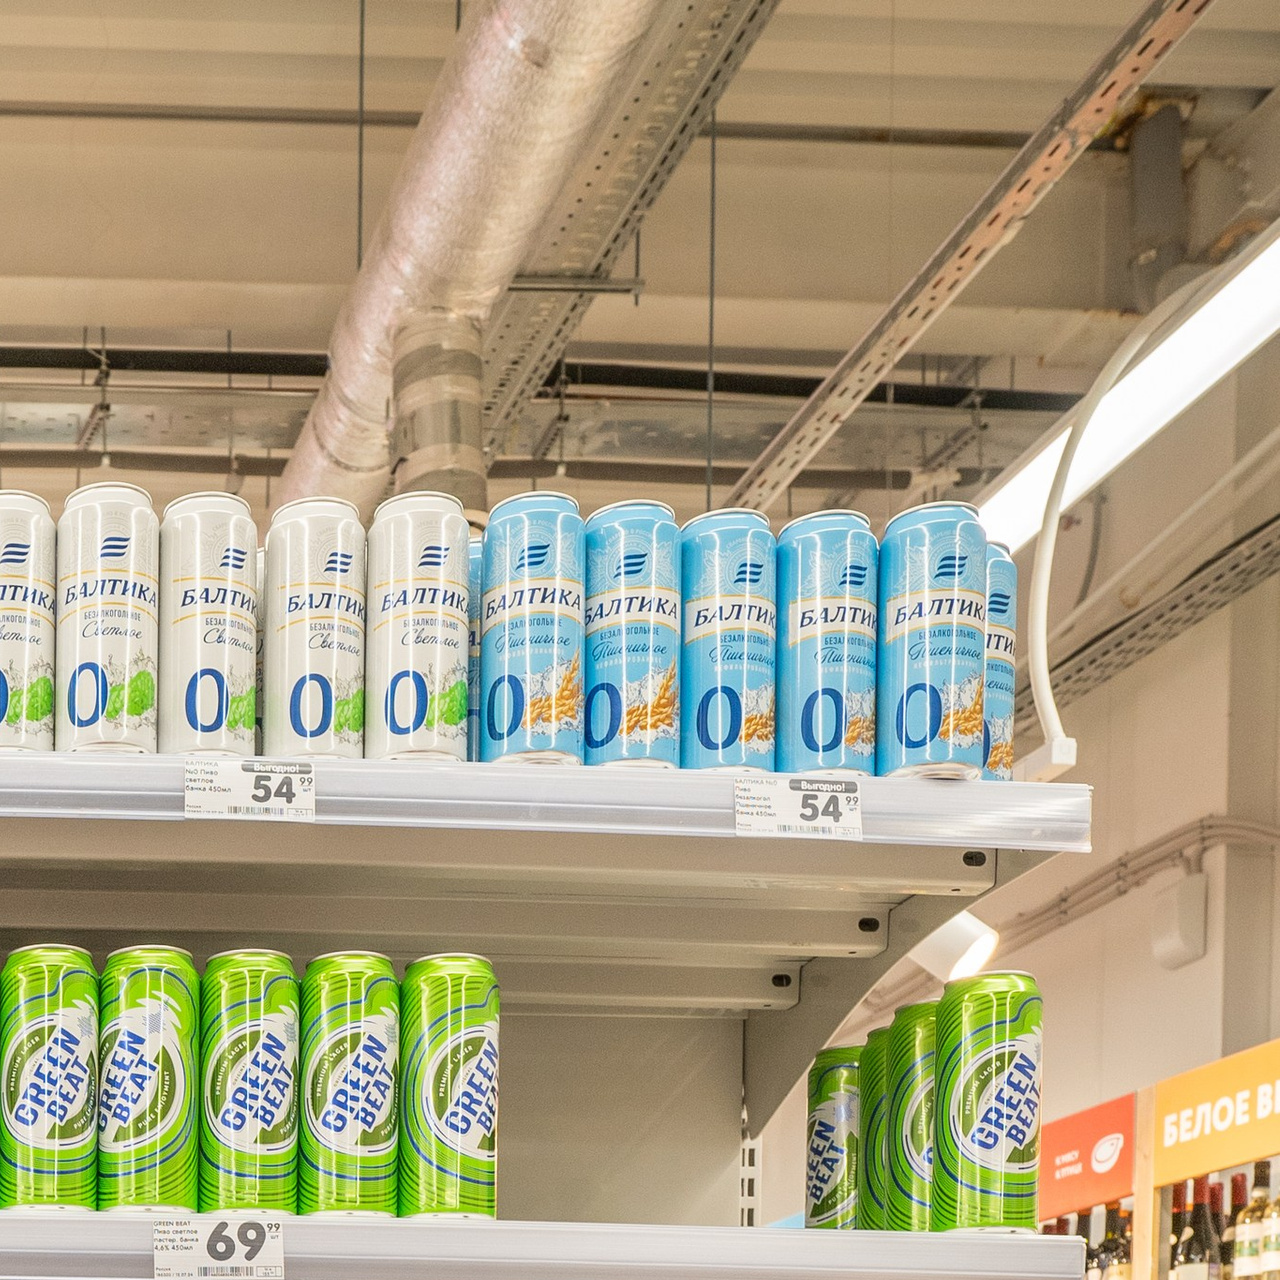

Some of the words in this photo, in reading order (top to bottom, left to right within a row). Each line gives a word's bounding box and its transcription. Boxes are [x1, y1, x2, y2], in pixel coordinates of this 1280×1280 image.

[485, 588, 581, 619] БАЛТИКА
[495, 632, 570, 653] Пшеничное
[254, 763, 300, 773] Выгодно!
[252, 775, 295, 803] 54
[299, 777, 313, 786] 99
[801, 781, 845, 792] Выгодно!
[799, 794, 841, 822] 54
[845, 796, 859, 806] 99
[1163, 1090, 1250, 1147] БЕЛОЕ
[207, 1222, 266, 1262] 69
[267, 1223, 280, 1232] 99
